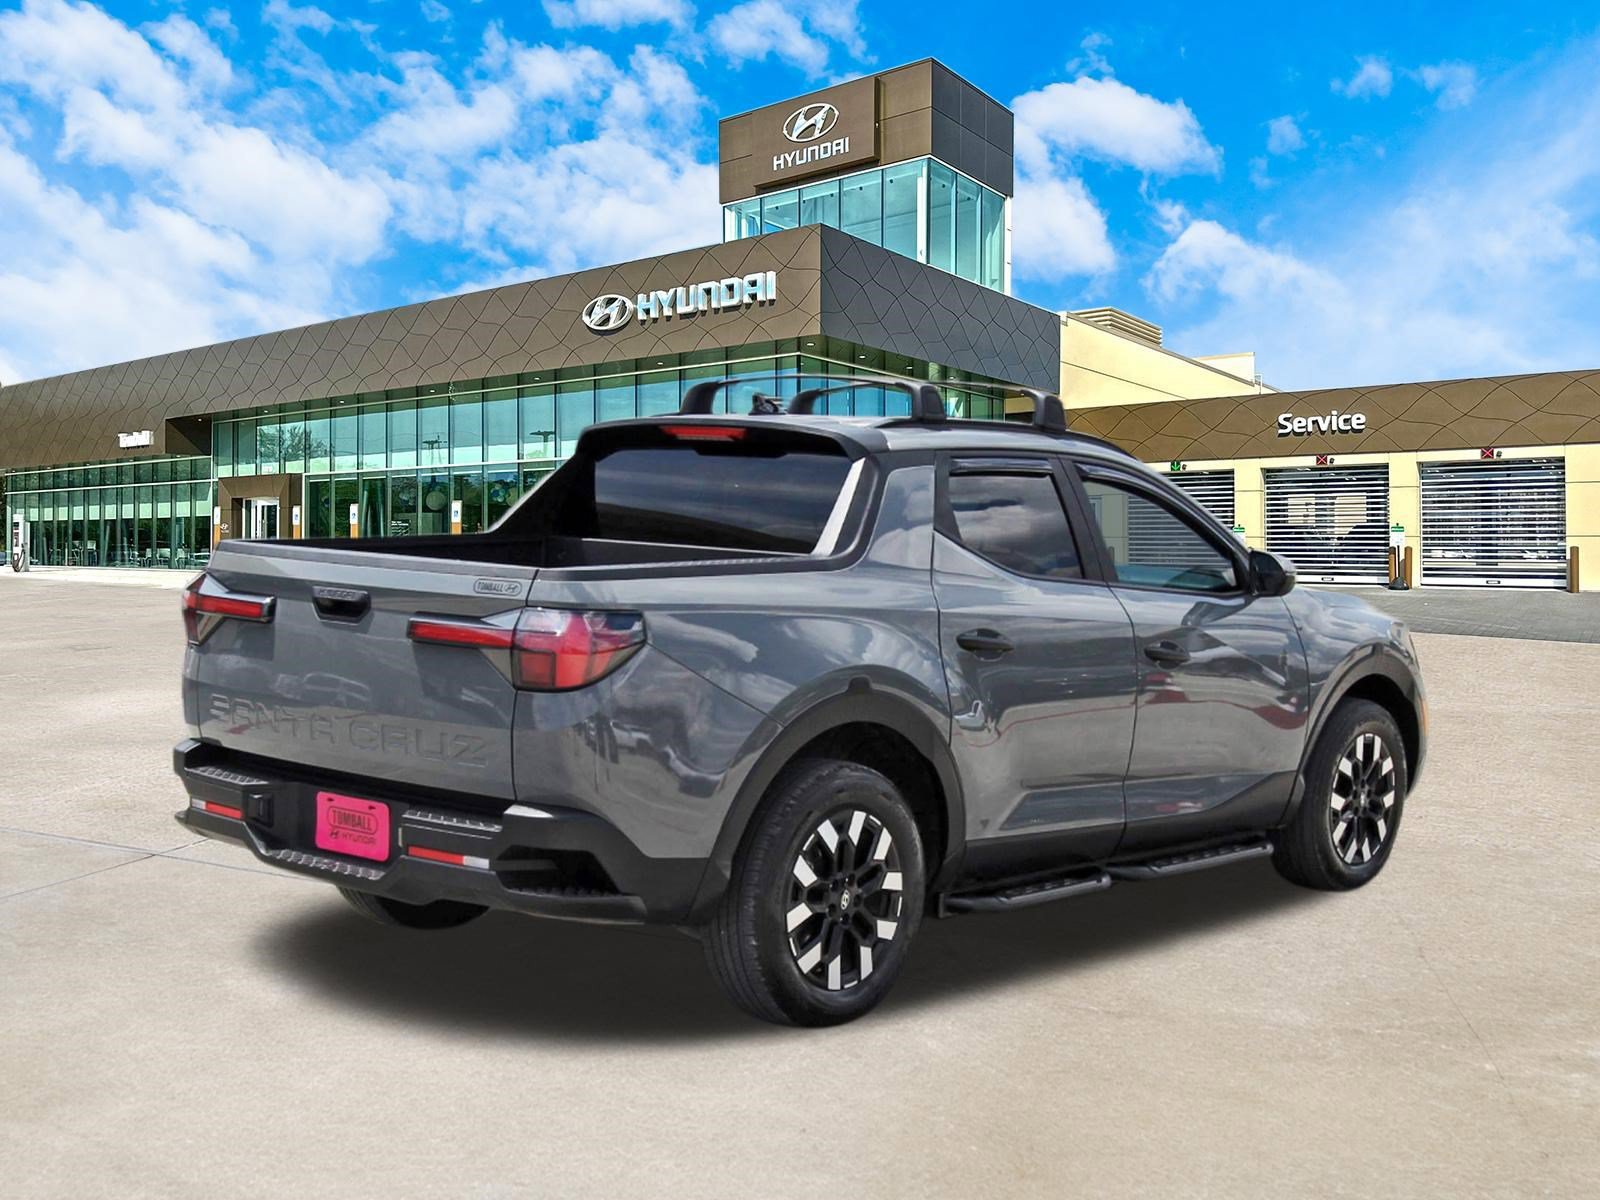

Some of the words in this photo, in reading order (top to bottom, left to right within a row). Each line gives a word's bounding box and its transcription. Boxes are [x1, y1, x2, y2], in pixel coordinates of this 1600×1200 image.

[773, 137, 849, 171] HYUNDAI
[637, 270, 777, 321] HYUNDAI
[1277, 410, 1366, 435] Service
[208, 692, 336, 745] SANTA
[349, 718, 489, 769] CRUZ
[332, 808, 373, 832] TOMBALL
